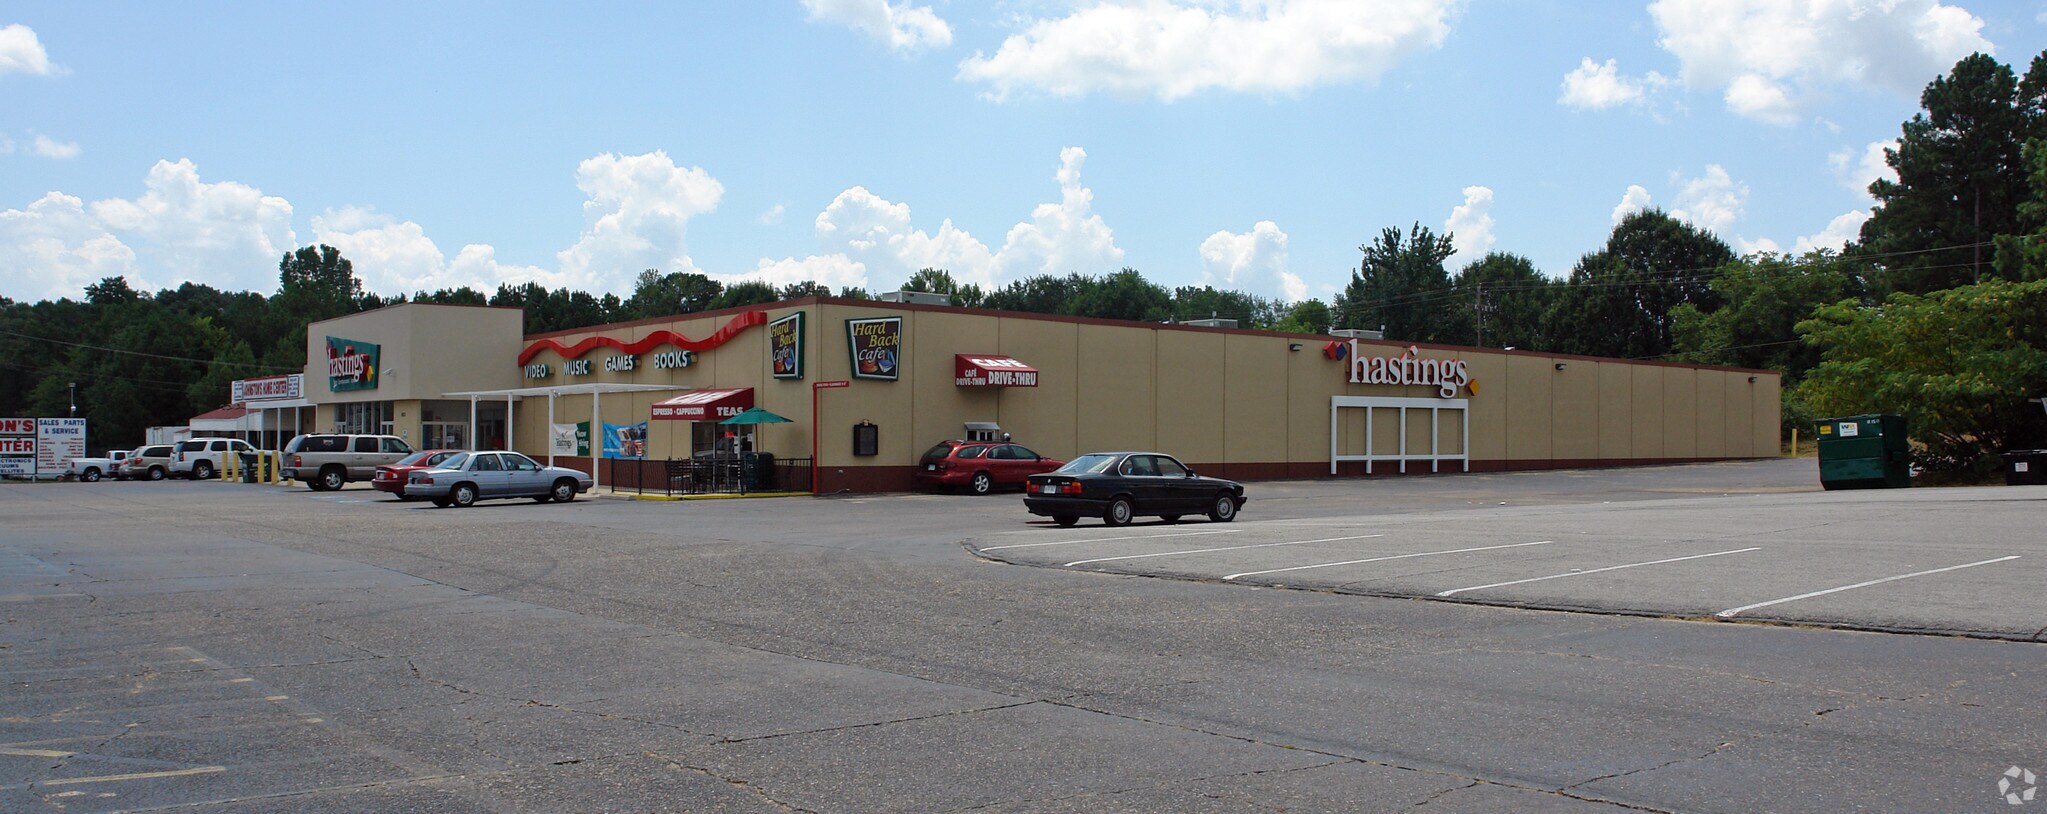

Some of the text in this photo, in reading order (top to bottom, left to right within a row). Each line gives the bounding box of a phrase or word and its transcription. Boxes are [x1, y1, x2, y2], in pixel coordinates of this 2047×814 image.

[770, 319, 790, 338] Hard
[854, 321, 886, 336] Hard
[779, 328, 798, 348] Back
[868, 332, 899, 348] Back
[773, 345, 790, 362] Cafe
[858, 347, 886, 363] Cafe
[328, 346, 365, 383] hastings
[524, 350, 690, 378] VIDEO MUSIC GAMES BOOKS
[1347, 338, 1468, 398] hastings
[956, 377, 987, 386] DRIVE-THRU
[988, 371, 1037, 386] DRIVE-THRU
[652, 407, 705, 416] ESPRESSO CAPPUCCINO
[716, 406, 744, 417] TEAS
